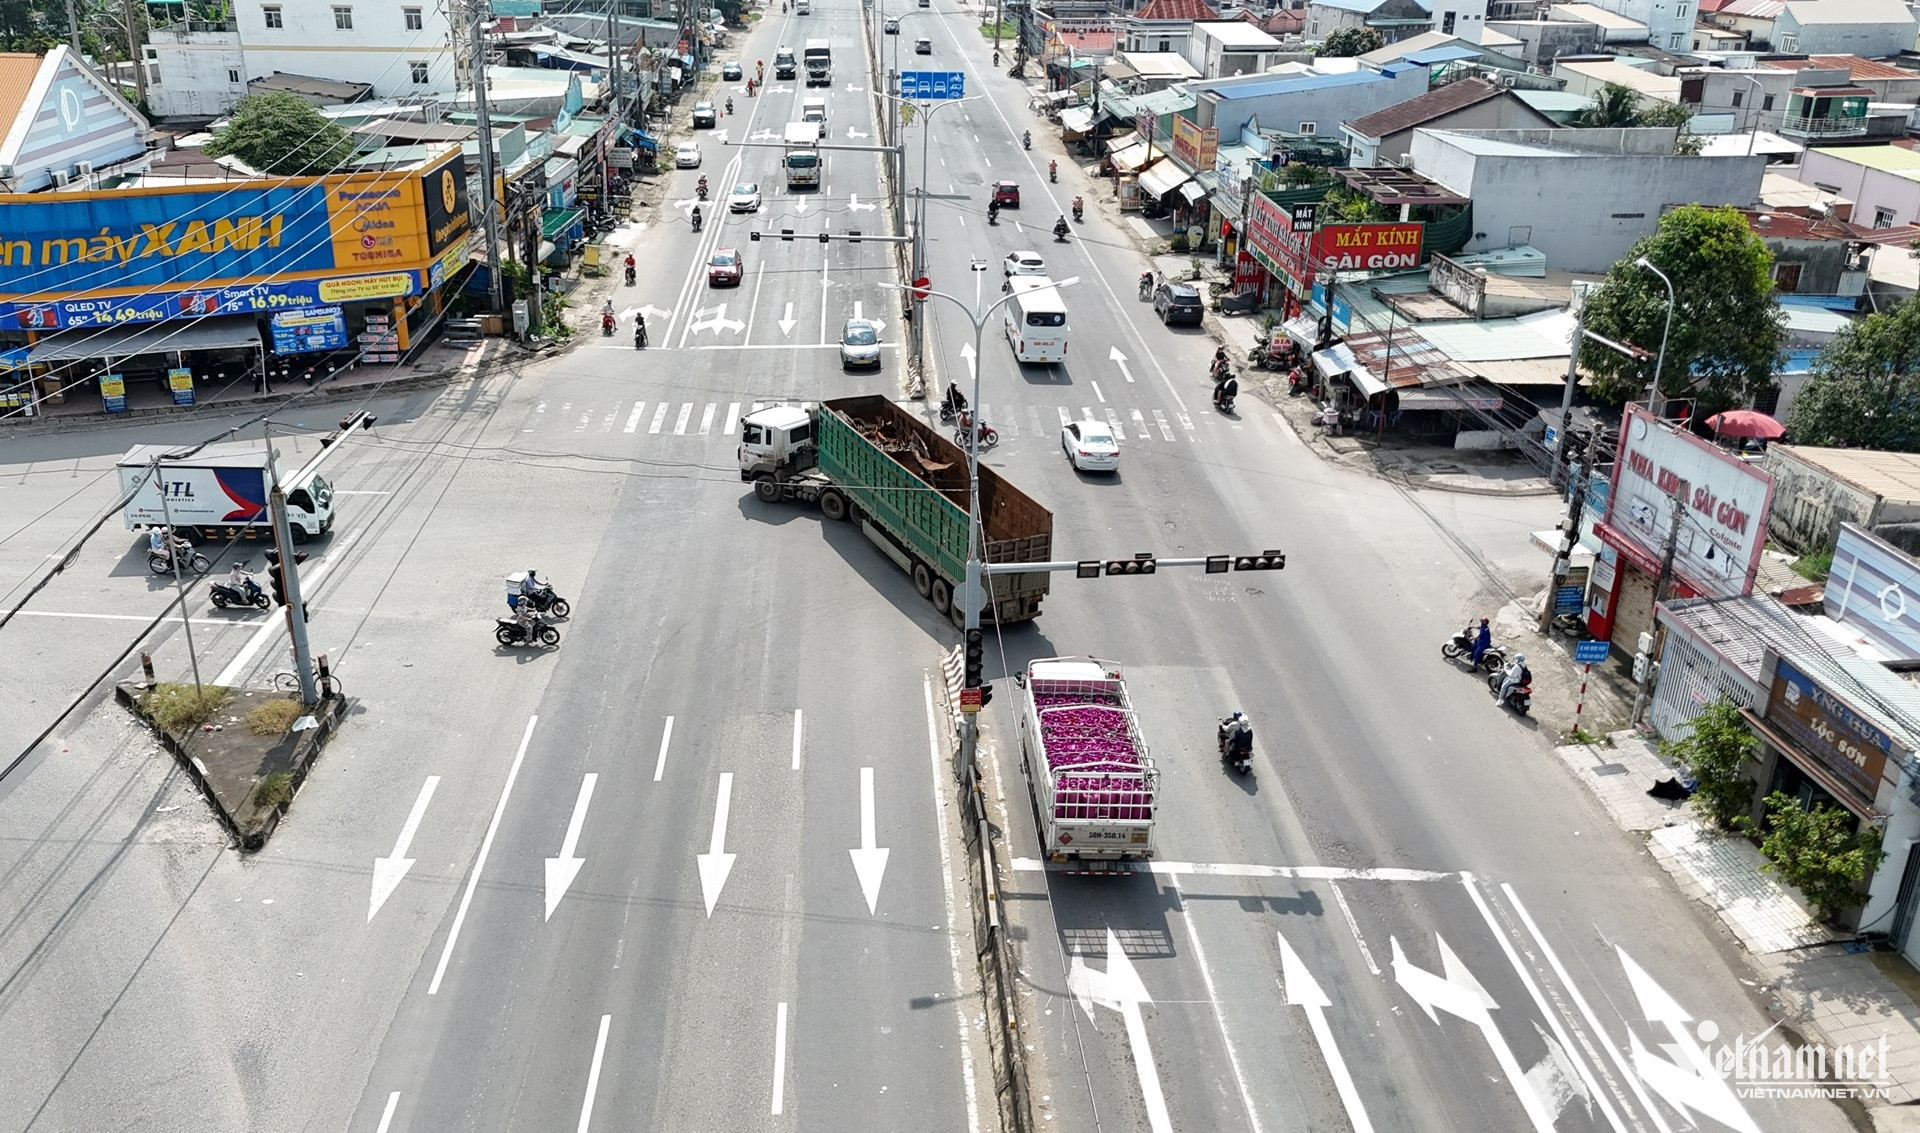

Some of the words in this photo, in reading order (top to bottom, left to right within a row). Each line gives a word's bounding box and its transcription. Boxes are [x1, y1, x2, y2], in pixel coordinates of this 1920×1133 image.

[338, 188, 400, 201] Panasonic
[1294, 220, 1312, 230] KÍNH
[41, 226, 140, 269] máy
[139, 213, 284, 258] XANH
[1336, 226, 1372, 247] MẮT
[1376, 227, 1418, 246] KÍNH
[352, 249, 403, 261] TOSHIBA
[1324, 252, 1362, 270] SÀI
[1368, 251, 1416, 268] GÒN
[224, 289, 254, 299] Smart
[256, 286, 269, 295] TV
[1236, 279, 1259, 296] KÍNH
[65, 302, 95, 313] QLED
[97, 301, 111, 310] TV
[226, 302, 243, 311] 75"
[68, 316, 88, 326] 65"
[1629, 449, 1654, 481] NHA
[1656, 466, 1691, 505] KHA
[1692, 483, 1717, 518] SÀI
[1717, 498, 1750, 536] GÒN
[1709, 528, 1742, 551] Colgate
[1810, 717, 1835, 742] LỘC
[1838, 740, 1867, 767] SƠN
